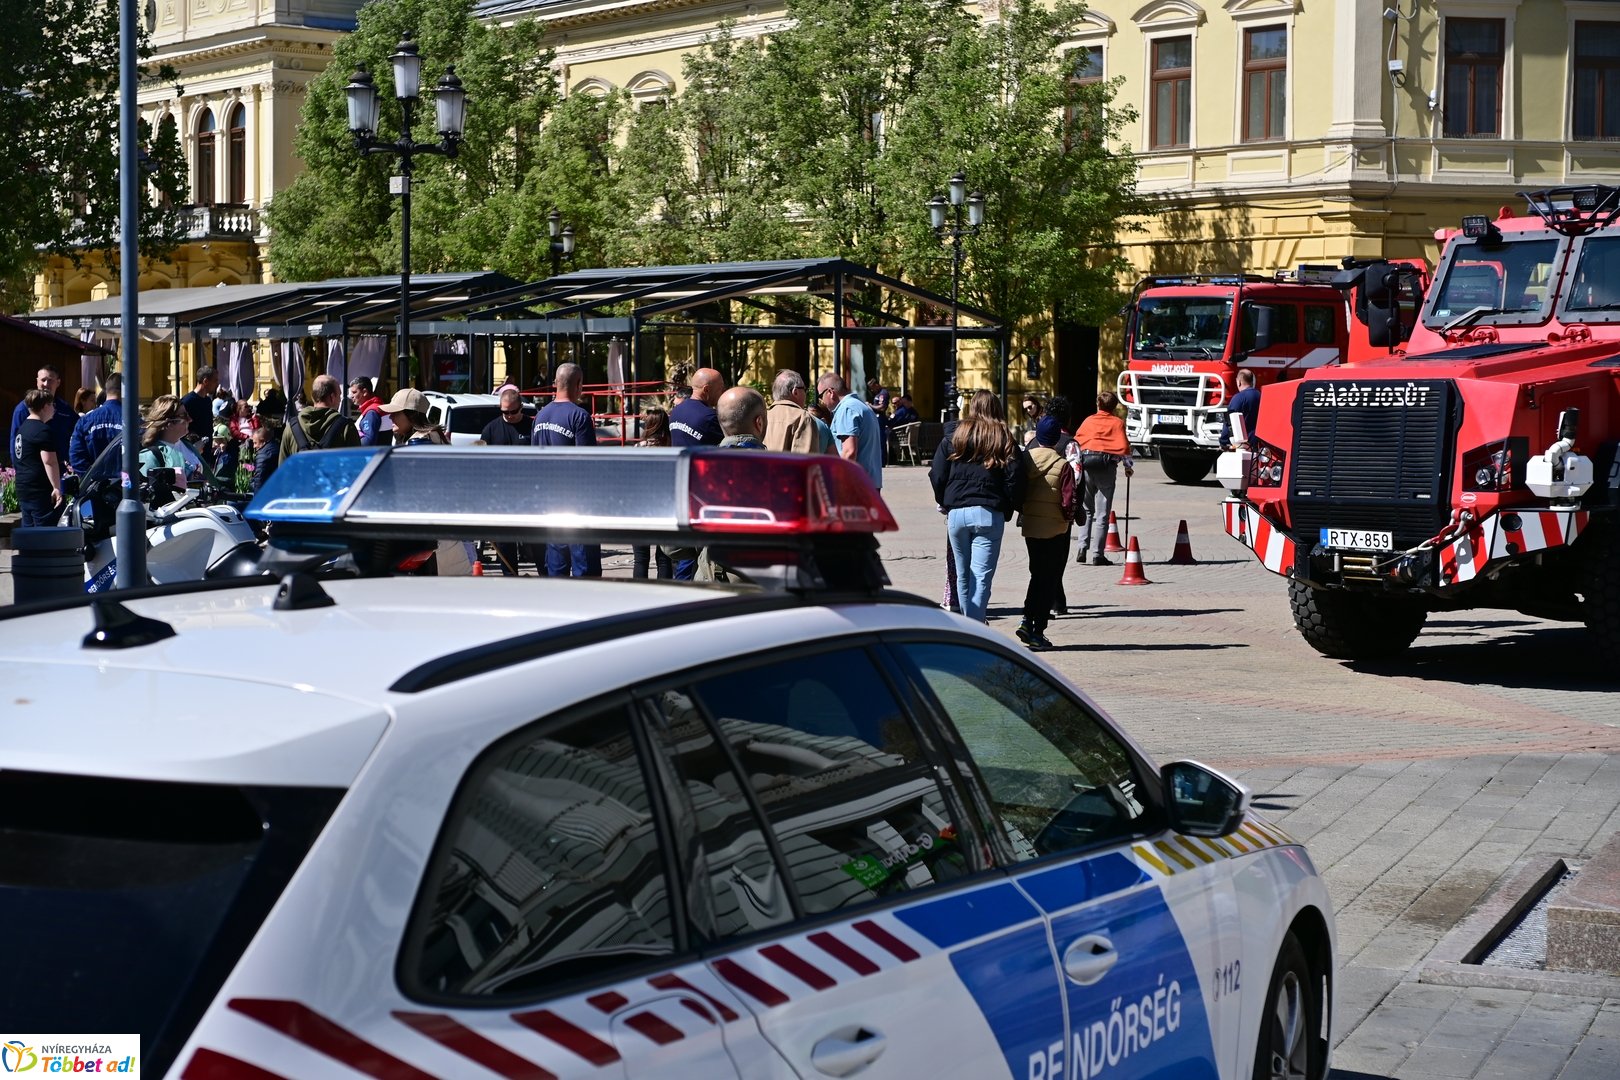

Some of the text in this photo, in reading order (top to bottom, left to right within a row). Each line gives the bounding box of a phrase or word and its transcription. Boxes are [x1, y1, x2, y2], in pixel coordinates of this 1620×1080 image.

[48, 319, 62, 327] COFFEE
[100, 317, 111, 326] PIZZA
[1330, 531, 1389, 548] RTX-859
[1222, 959, 1241, 996] 112
